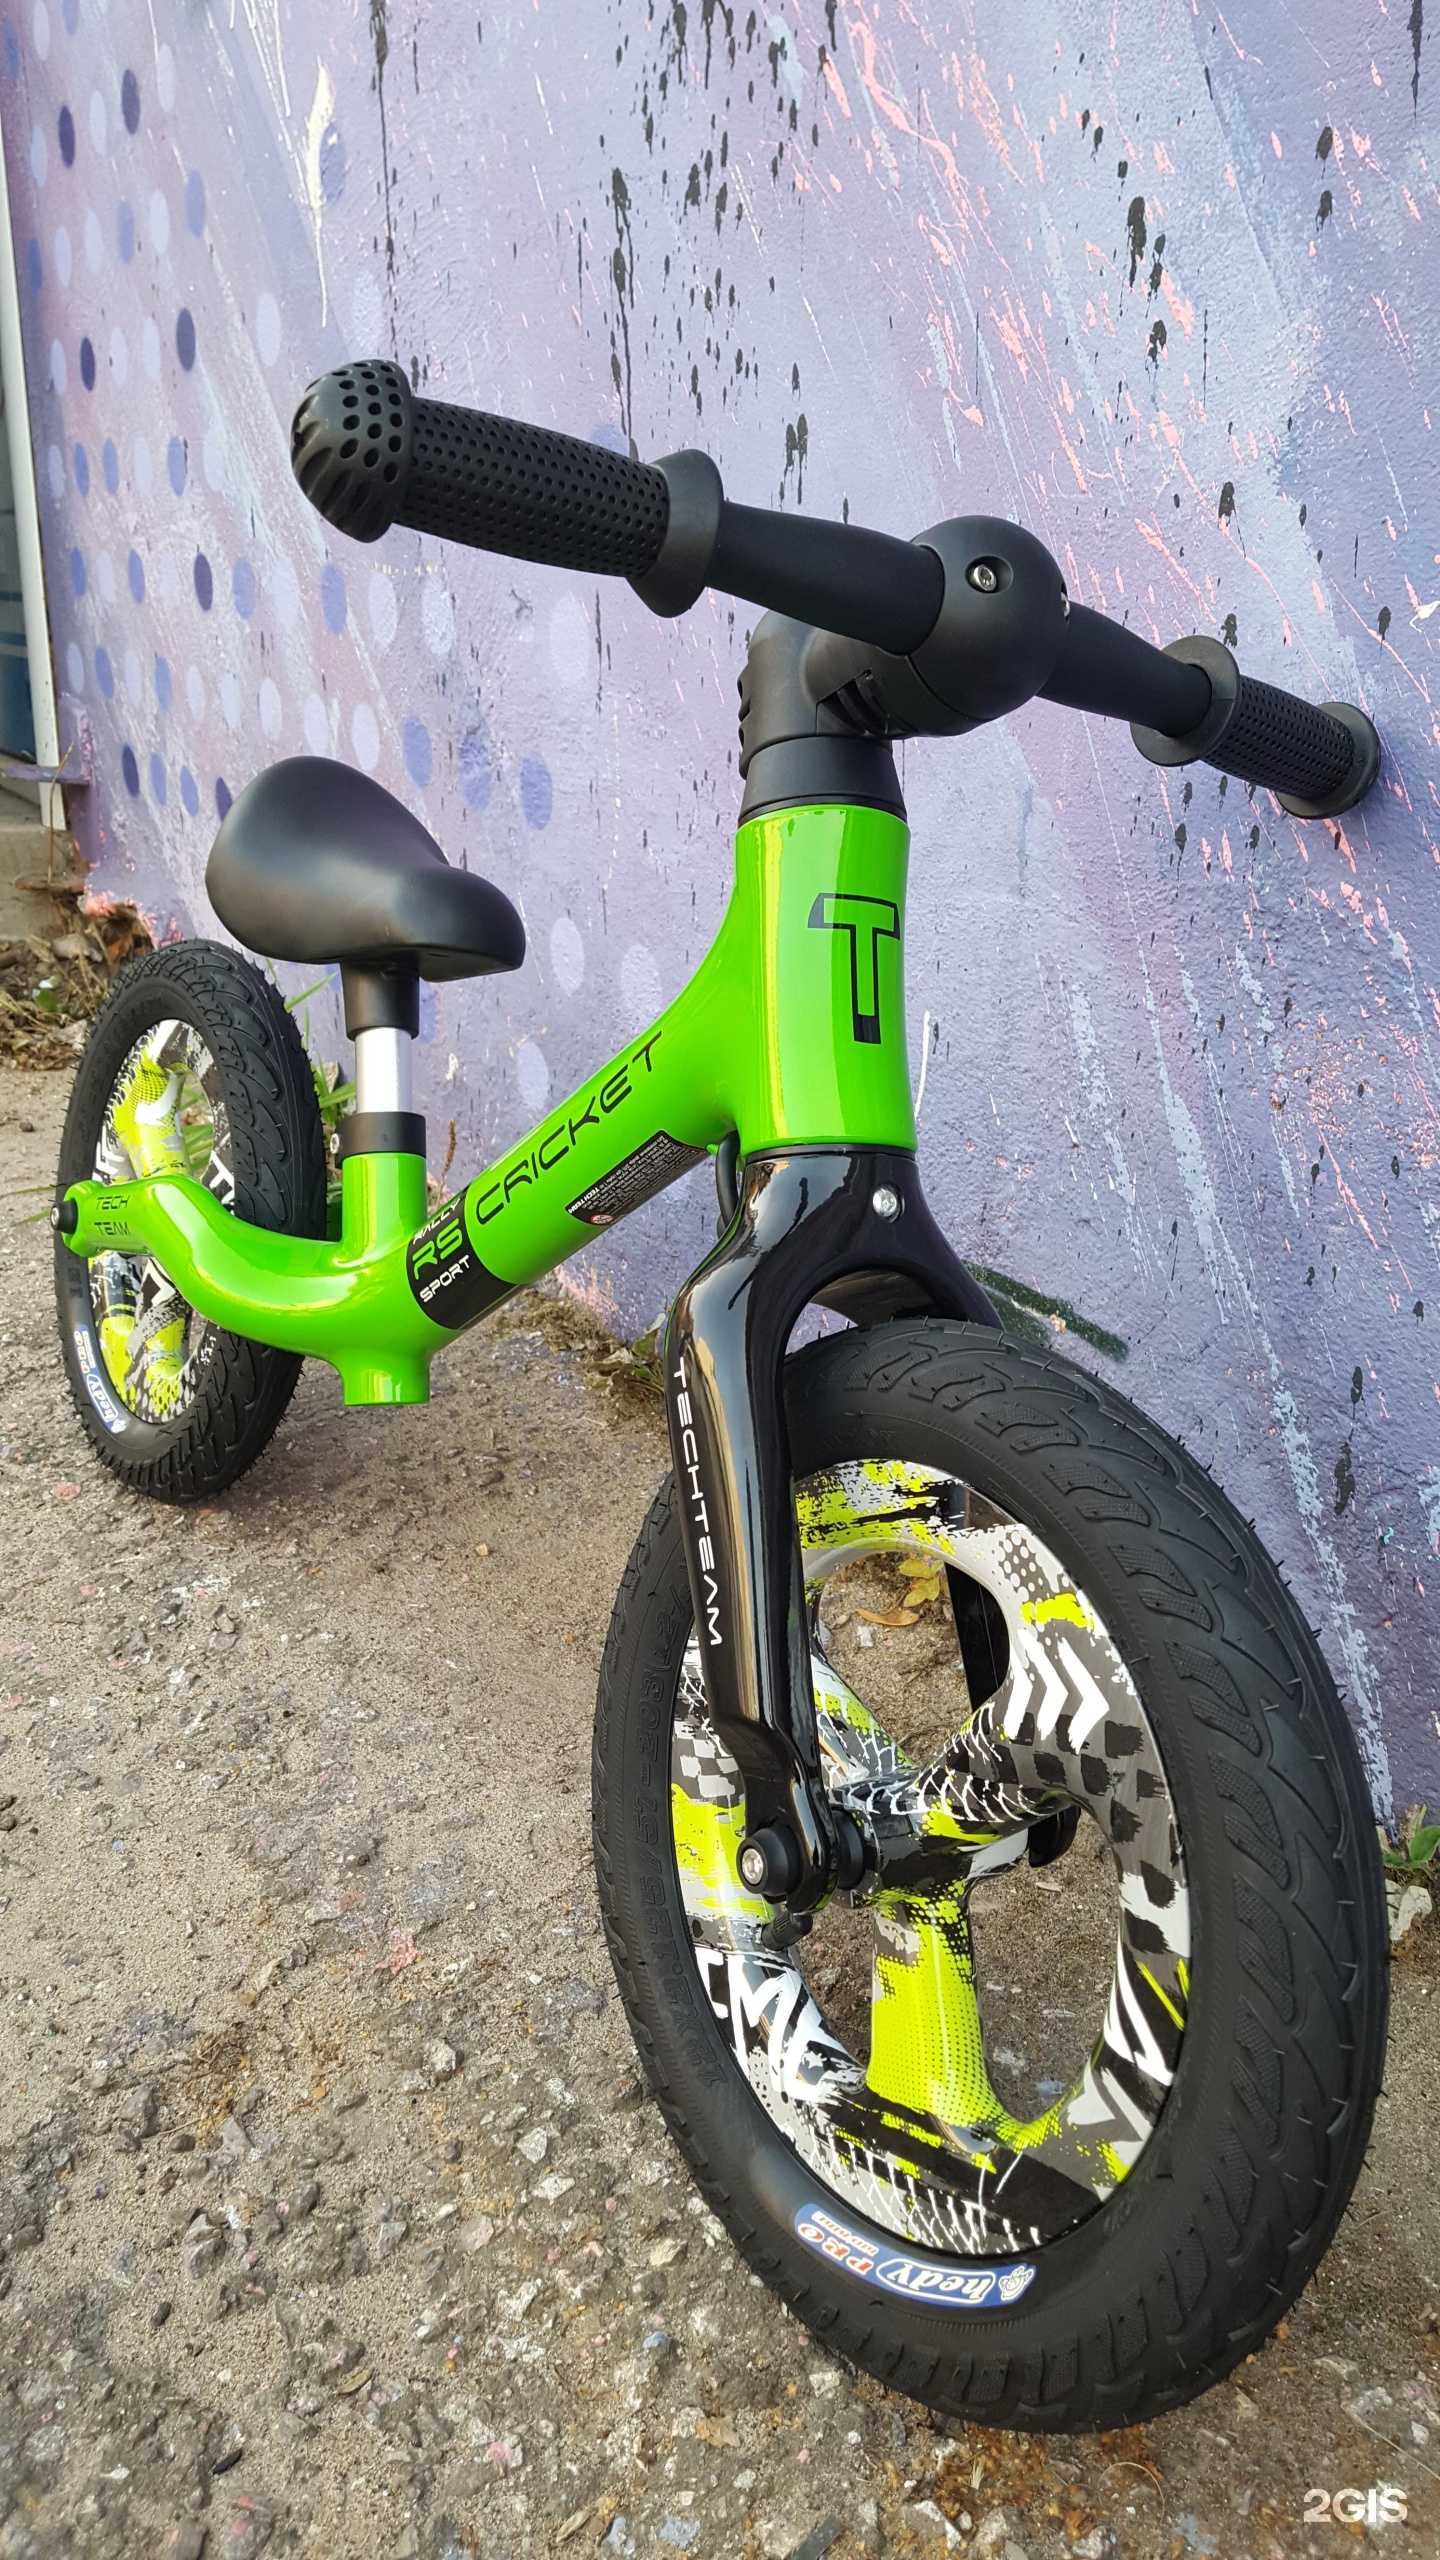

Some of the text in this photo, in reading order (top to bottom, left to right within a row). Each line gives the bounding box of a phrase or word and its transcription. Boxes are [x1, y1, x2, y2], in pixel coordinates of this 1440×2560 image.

[807, 892, 900, 1044] T
[476, 1031, 662, 1225] CRICKET
[93, 1221, 130, 1236] TEAM
[95, 1195, 130, 1210] TECH
[412, 1217, 463, 1280] RS
[419, 1254, 470, 1302] SPORT
[673, 1356, 723, 1646] TECHTEAM
[797, 2222, 875, 2277] PRO
[886, 2263, 994, 2300] hedy
